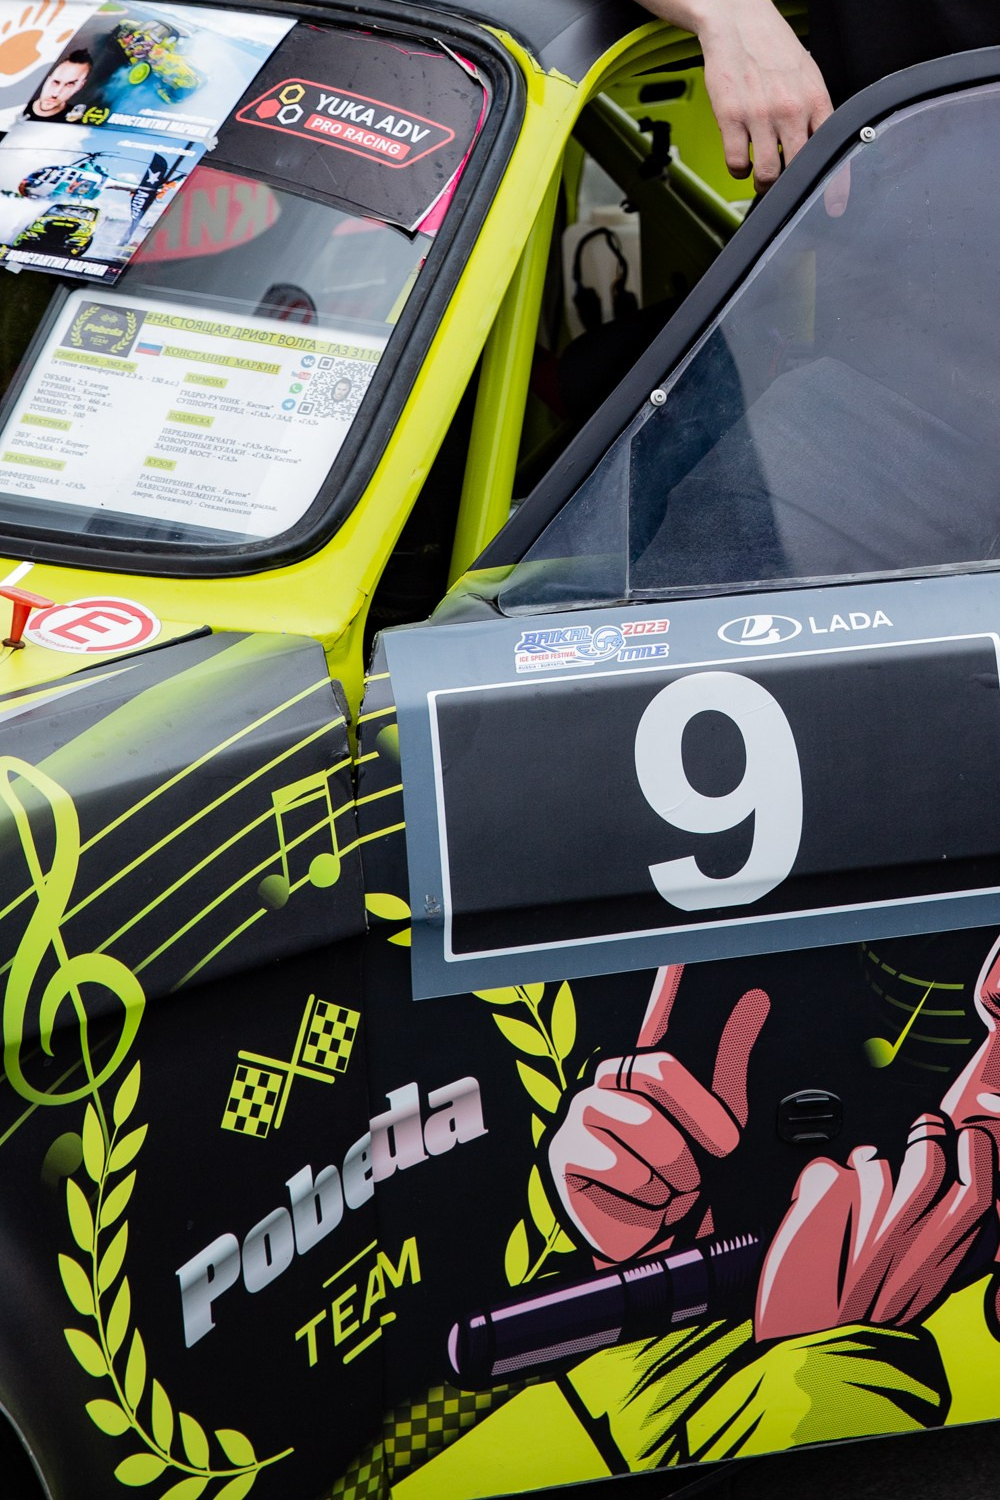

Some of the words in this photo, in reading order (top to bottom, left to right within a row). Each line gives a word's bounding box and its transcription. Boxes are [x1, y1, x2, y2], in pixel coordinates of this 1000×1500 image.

[310, 117, 342, 135] PRO
[342, 127, 402, 156] RACING
[315, 93, 373, 128] YUKA
[374, 114, 432, 144] ADV
[145, 312, 231, 335] #НАСТОЯЩАЯ
[231, 327, 277, 344] ДРИФТ
[277, 334, 319, 350] ВОЛГА
[326, 342, 350, 355] ГАЗ
[234, 358, 280, 372] МАРКИН
[50, 610, 134, 645] E
[520, 626, 592, 646] BAIKAL
[622, 619, 669, 636] 2023
[808, 610, 894, 635] LADA
[518, 654, 531, 663] ICE
[531, 652, 550, 662] SPEED
[550, 650, 577, 660] FESTIVAL
[634, 671, 803, 911] 9
[174, 1075, 489, 1348] Pobeda
[295, 1236, 422, 1367] TEAM
